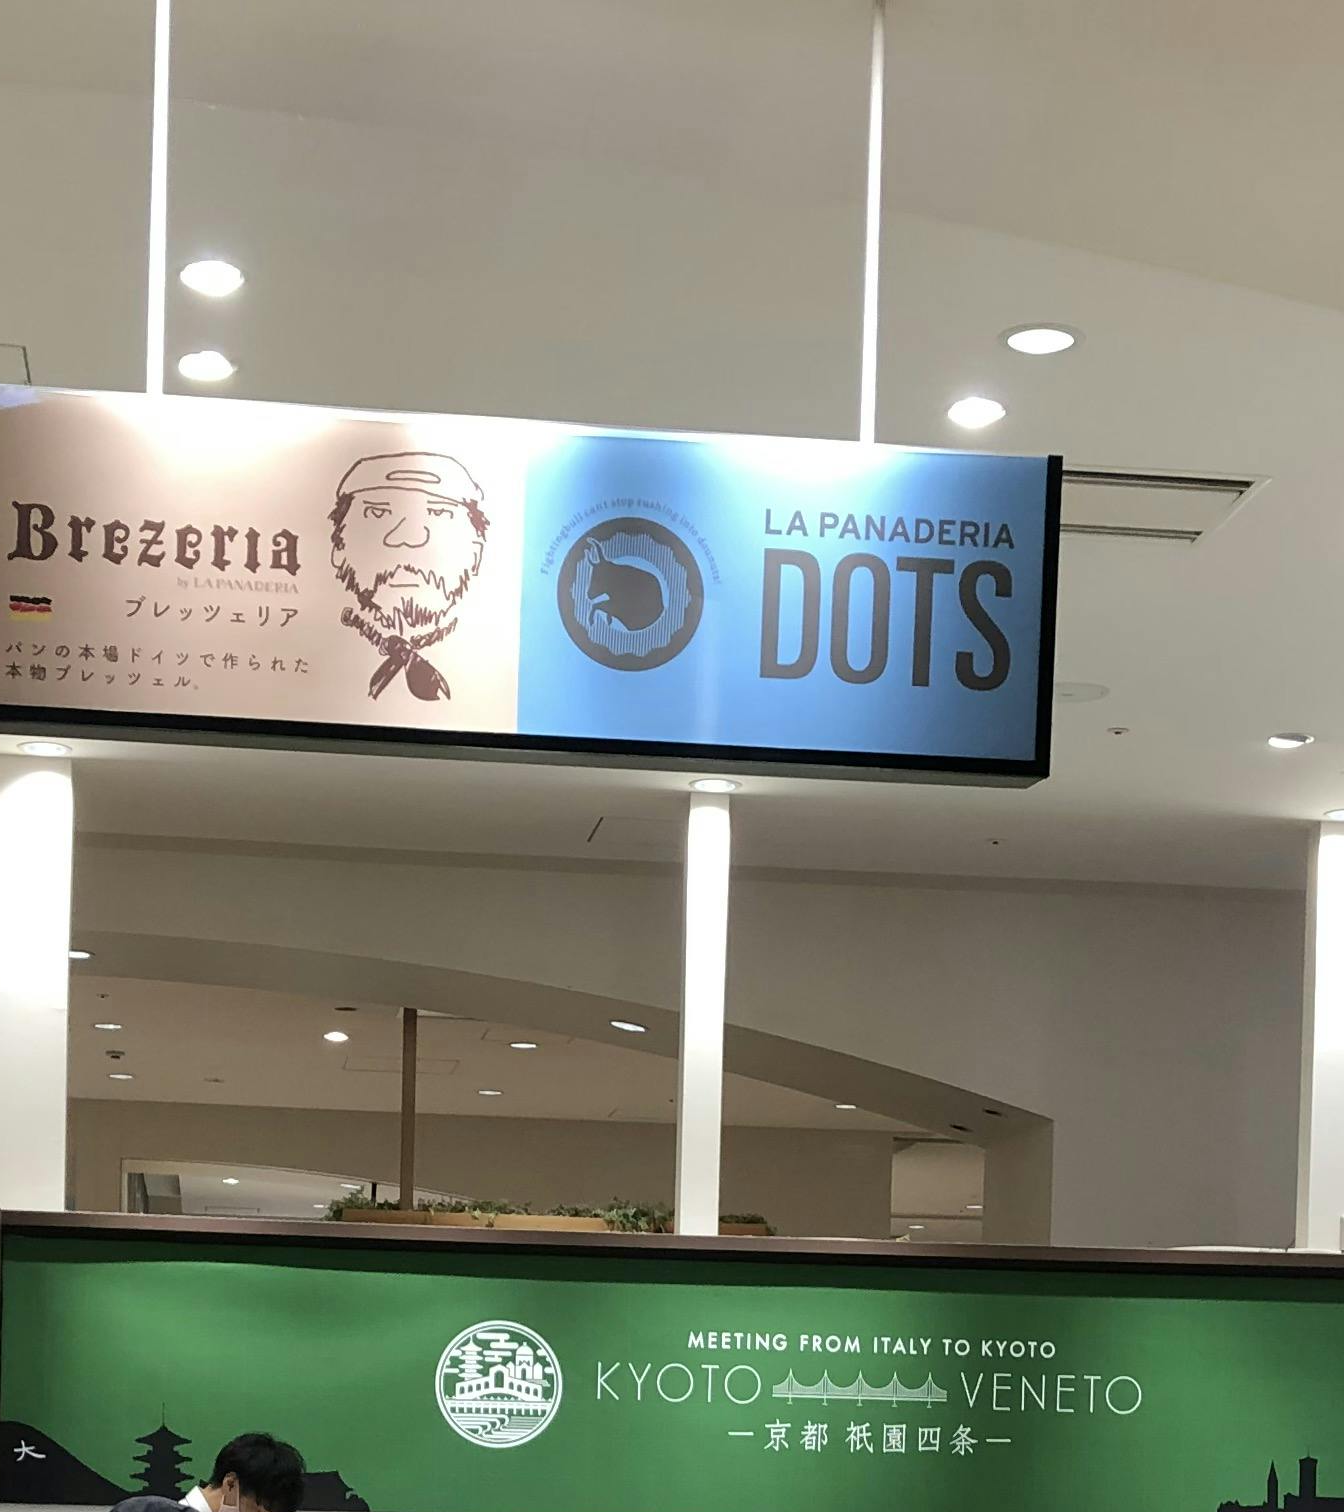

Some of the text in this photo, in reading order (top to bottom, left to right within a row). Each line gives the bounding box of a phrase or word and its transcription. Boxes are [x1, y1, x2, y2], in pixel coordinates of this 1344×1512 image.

[7, 500, 301, 576] Brezeria
[764, 508, 1015, 550] LA PANADERIA
[126, 596, 298, 627] ブレッツェリア
[759, 547, 1013, 692] DOTS
[6, 642, 309, 673] パンの本場ドイツで作られた
[687, 1331, 1056, 1359] MEETING FROM ITALY TO KYOTO
[597, 1361, 1143, 1415] KYOTO VENETO
